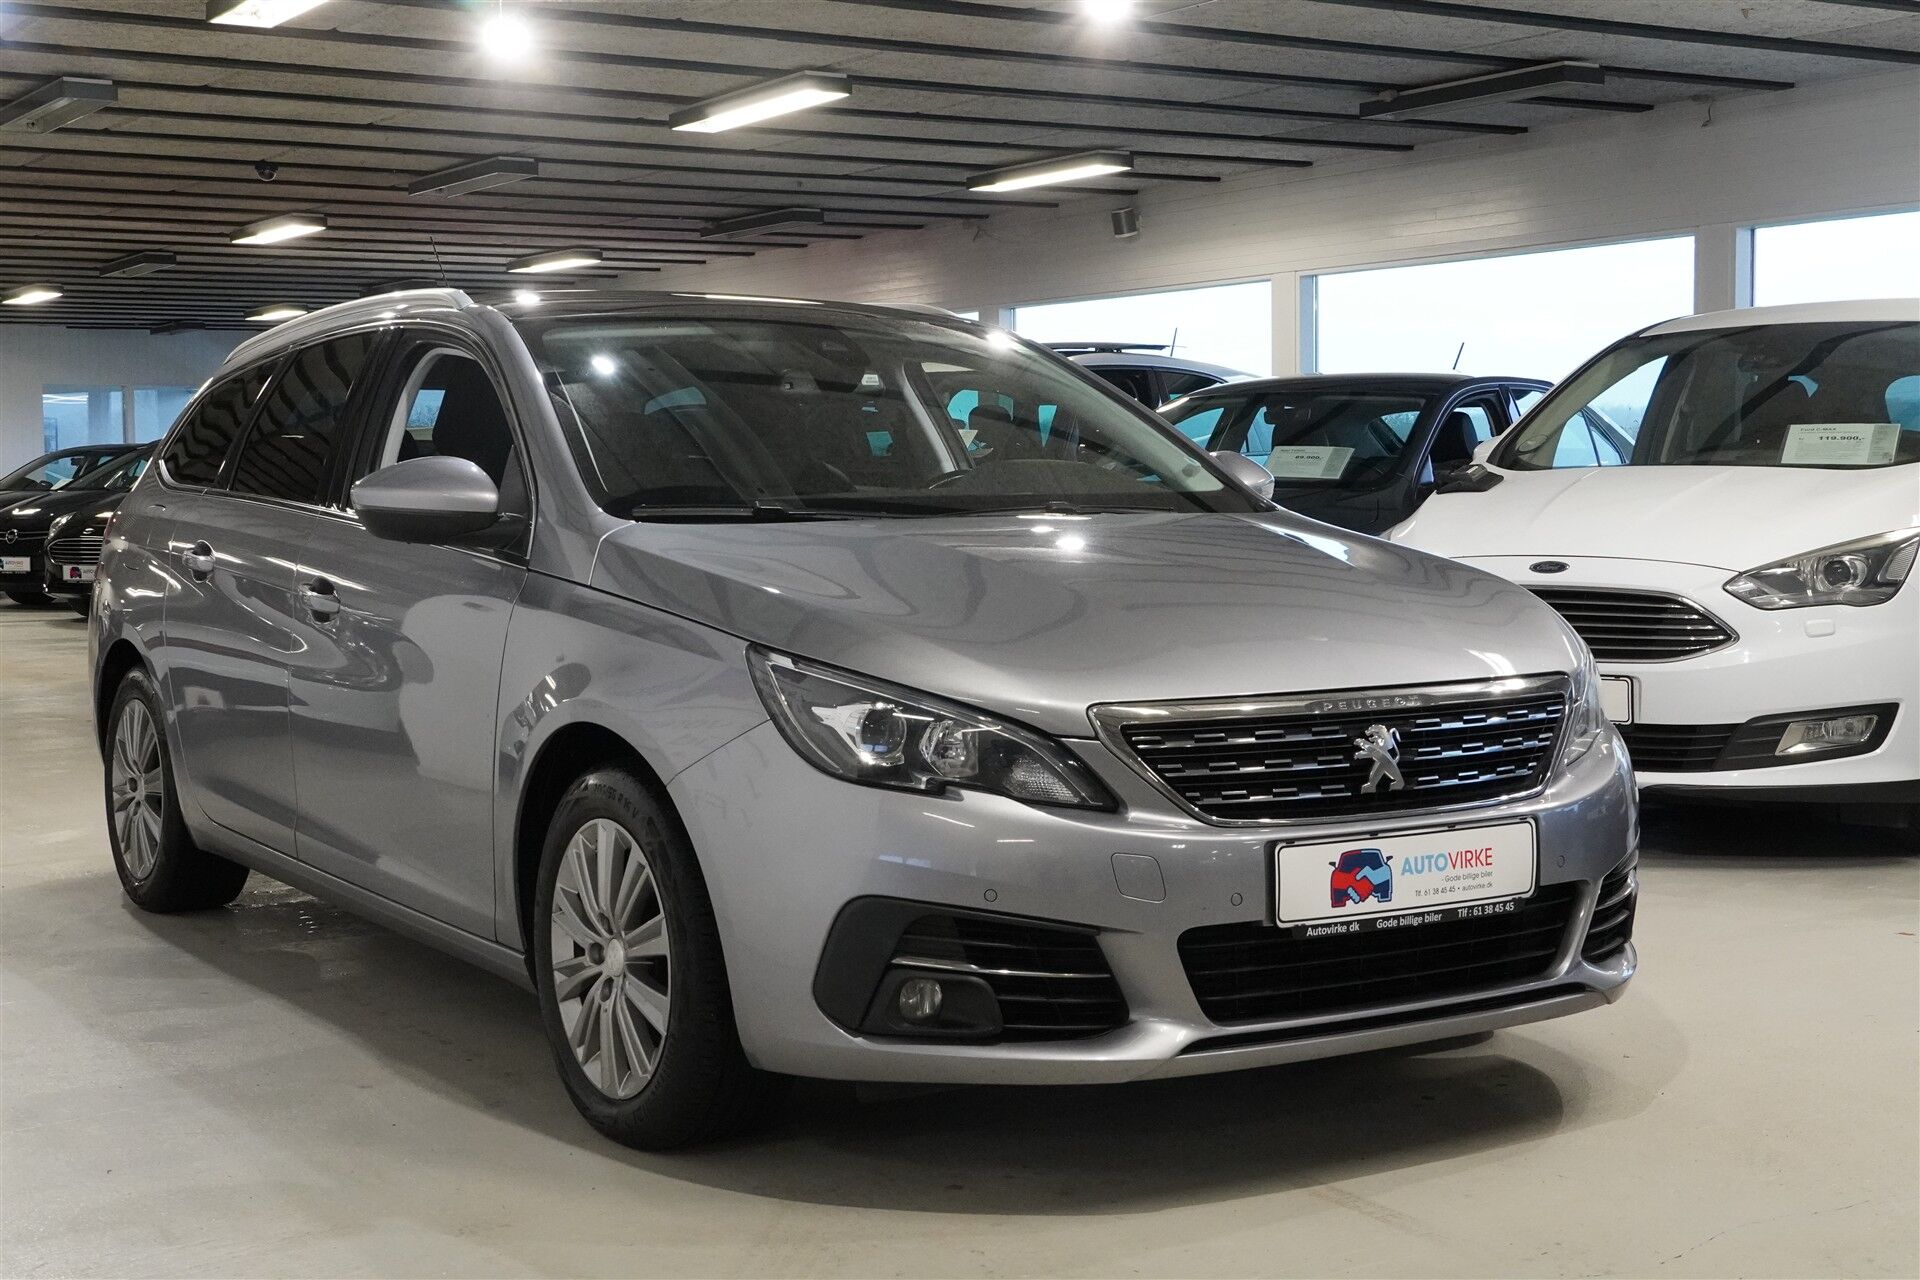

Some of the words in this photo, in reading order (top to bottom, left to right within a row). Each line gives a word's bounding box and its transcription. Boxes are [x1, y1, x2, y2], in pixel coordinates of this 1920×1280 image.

[1323, 696, 1421, 711] PEUGEOT
[1401, 847, 1493, 876] AUTOVIRKE
[1444, 874, 1461, 883] Gode
[1462, 872, 1480, 881] billige
[1480, 870, 1493, 879] biler
[1424, 888, 1431, 896] 61
[1432, 887, 1440, 895] 38
[1440, 886, 1448, 894] 45
[1448, 885, 1456, 893] 45
[1376, 918, 1398, 929] Gode
[1399, 914, 1423, 926] billige
[1424, 912, 1443, 923] biler
[1473, 906, 1483, 916] 61
[1484, 904, 1494, 914] 38
[1494, 903, 1504, 913] 45
[1505, 901, 1515, 911] 45
